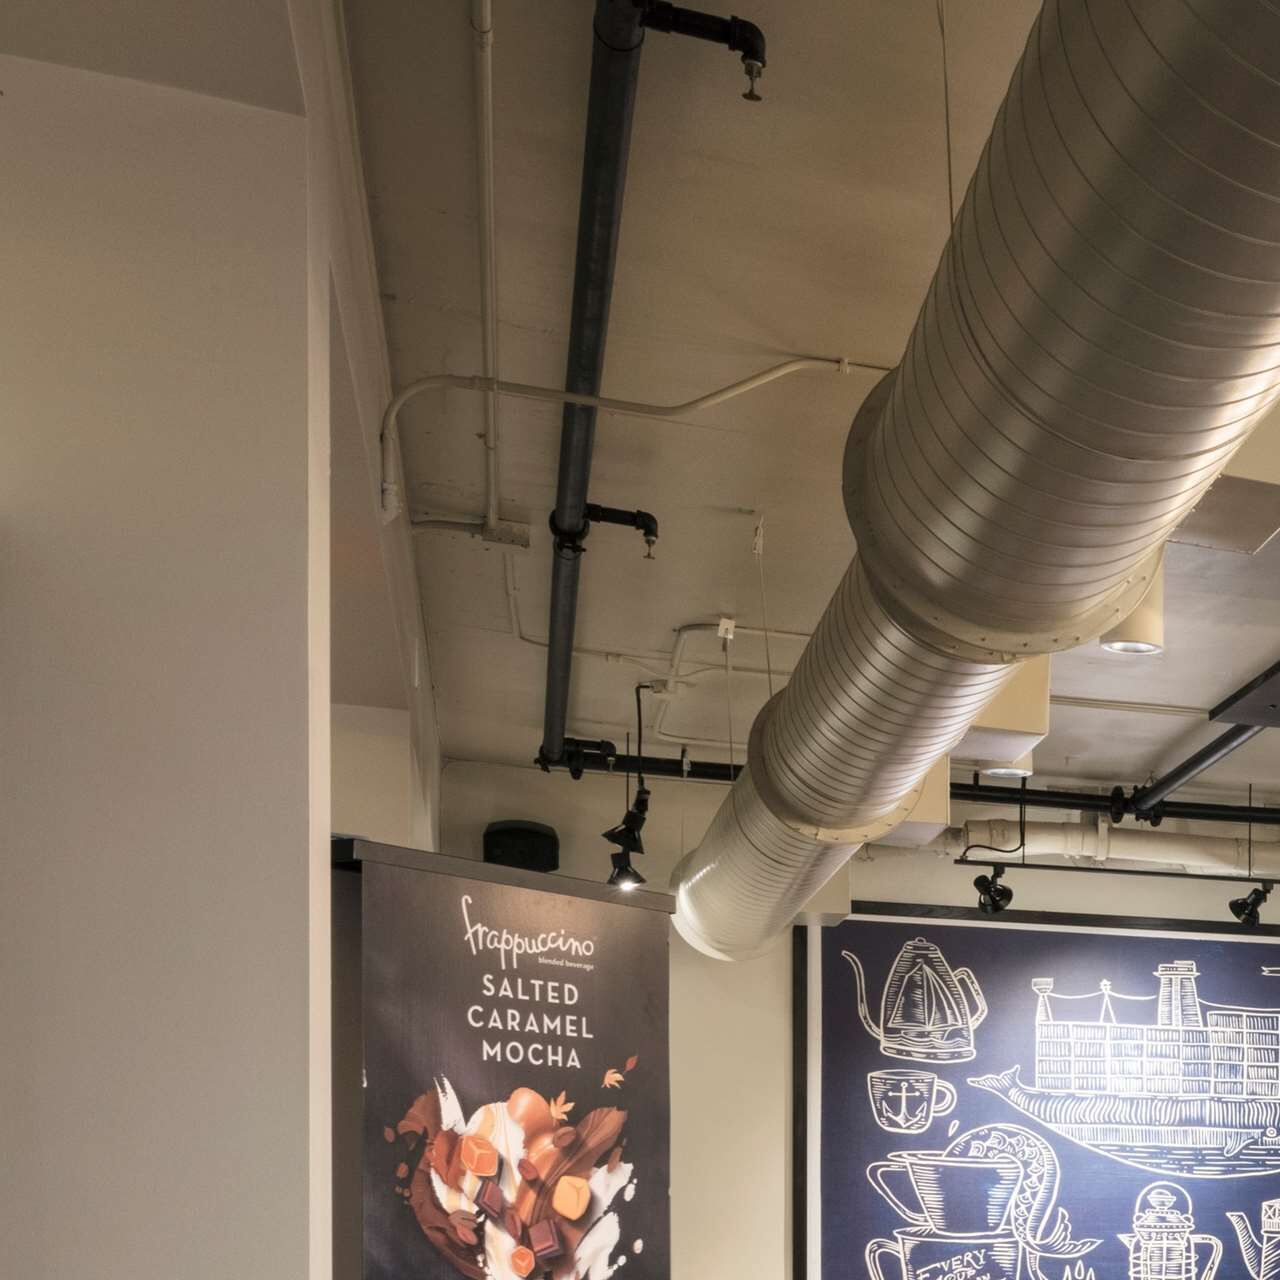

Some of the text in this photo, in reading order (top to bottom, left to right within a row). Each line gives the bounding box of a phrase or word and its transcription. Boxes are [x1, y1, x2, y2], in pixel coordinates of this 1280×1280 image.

[482, 973, 579, 1005] SALTED
[467, 1005, 594, 1039] CARAMEL
[482, 1039, 581, 1068] MOCHA
